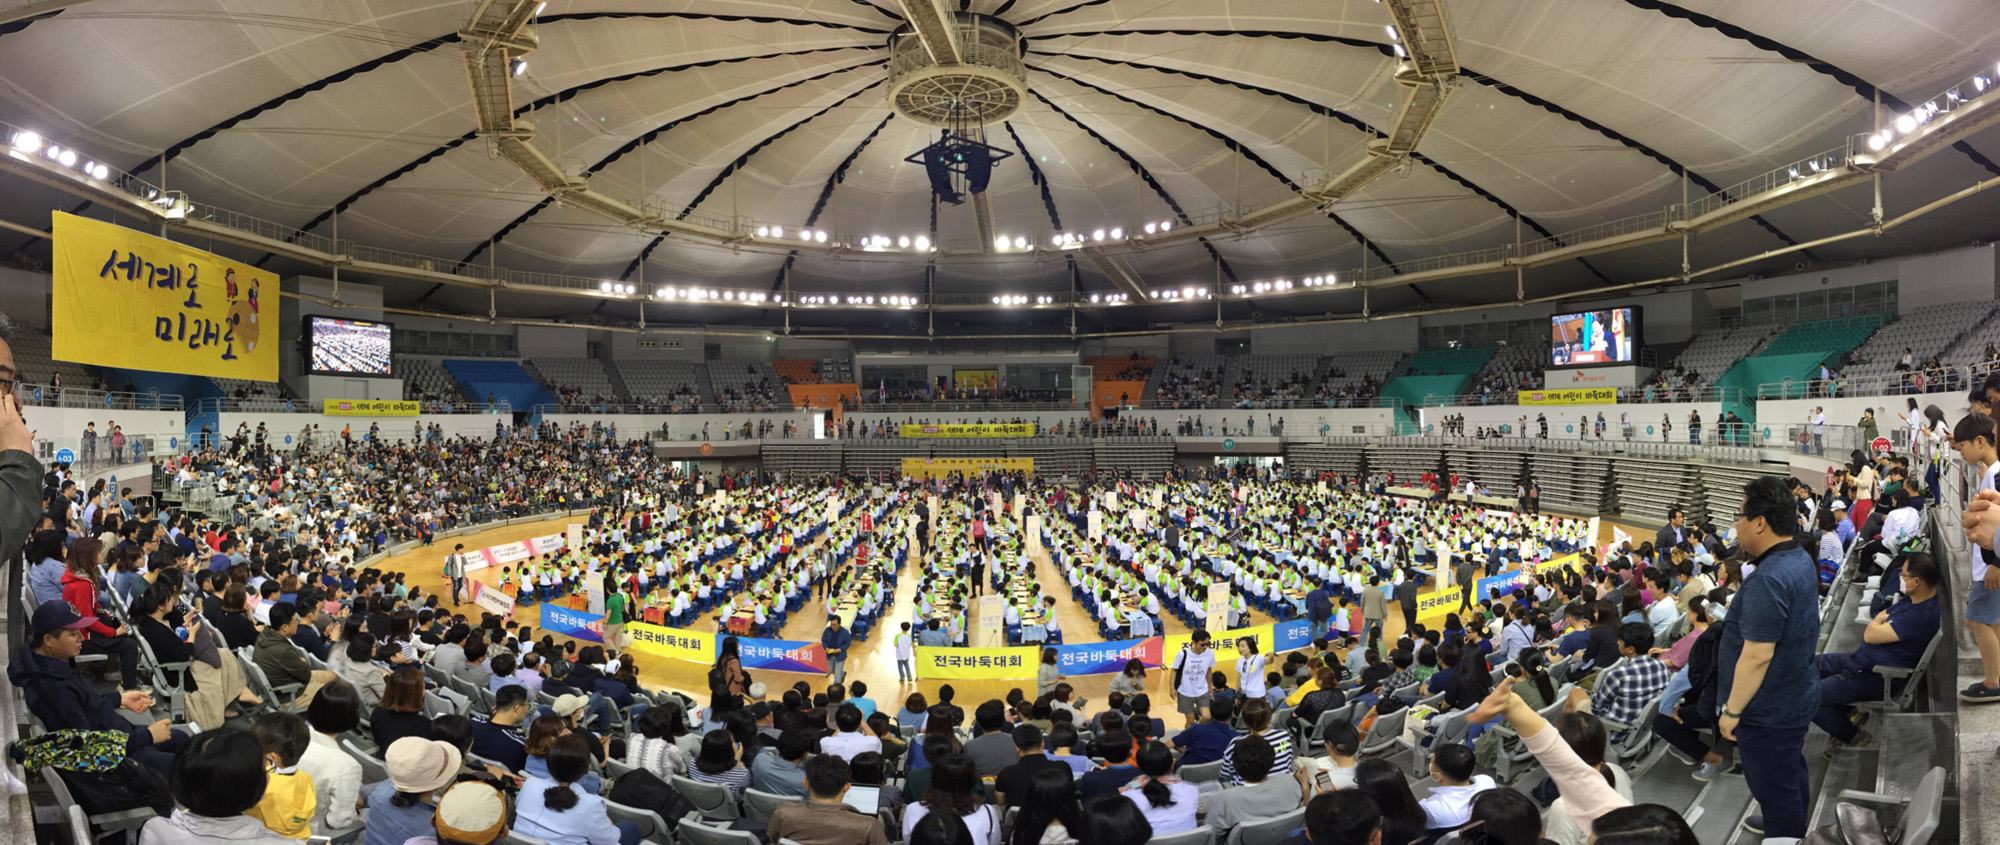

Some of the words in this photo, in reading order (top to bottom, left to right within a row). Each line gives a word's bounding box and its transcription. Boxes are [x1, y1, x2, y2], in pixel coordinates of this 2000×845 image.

[99, 249, 202, 309] 세계로
[155, 312, 238, 361] 미래로
[372, 402, 391, 412] 어린이
[393, 402, 417, 412] 바둑대회
[947, 426, 963, 434] 세계
[966, 426, 990, 435] 어린이
[994, 425, 1026, 434] 바둑대회
[1879, 444, 1889, 452] 02
[62, 455, 72, 463] 03
[1420, 591, 1463, 611] 전국바둑대
[632, 628, 701, 650] 전국바둑대회
[933, 655, 1022, 668] 전국바둑대회
[1062, 646, 1146, 666] 전국바둑대회
